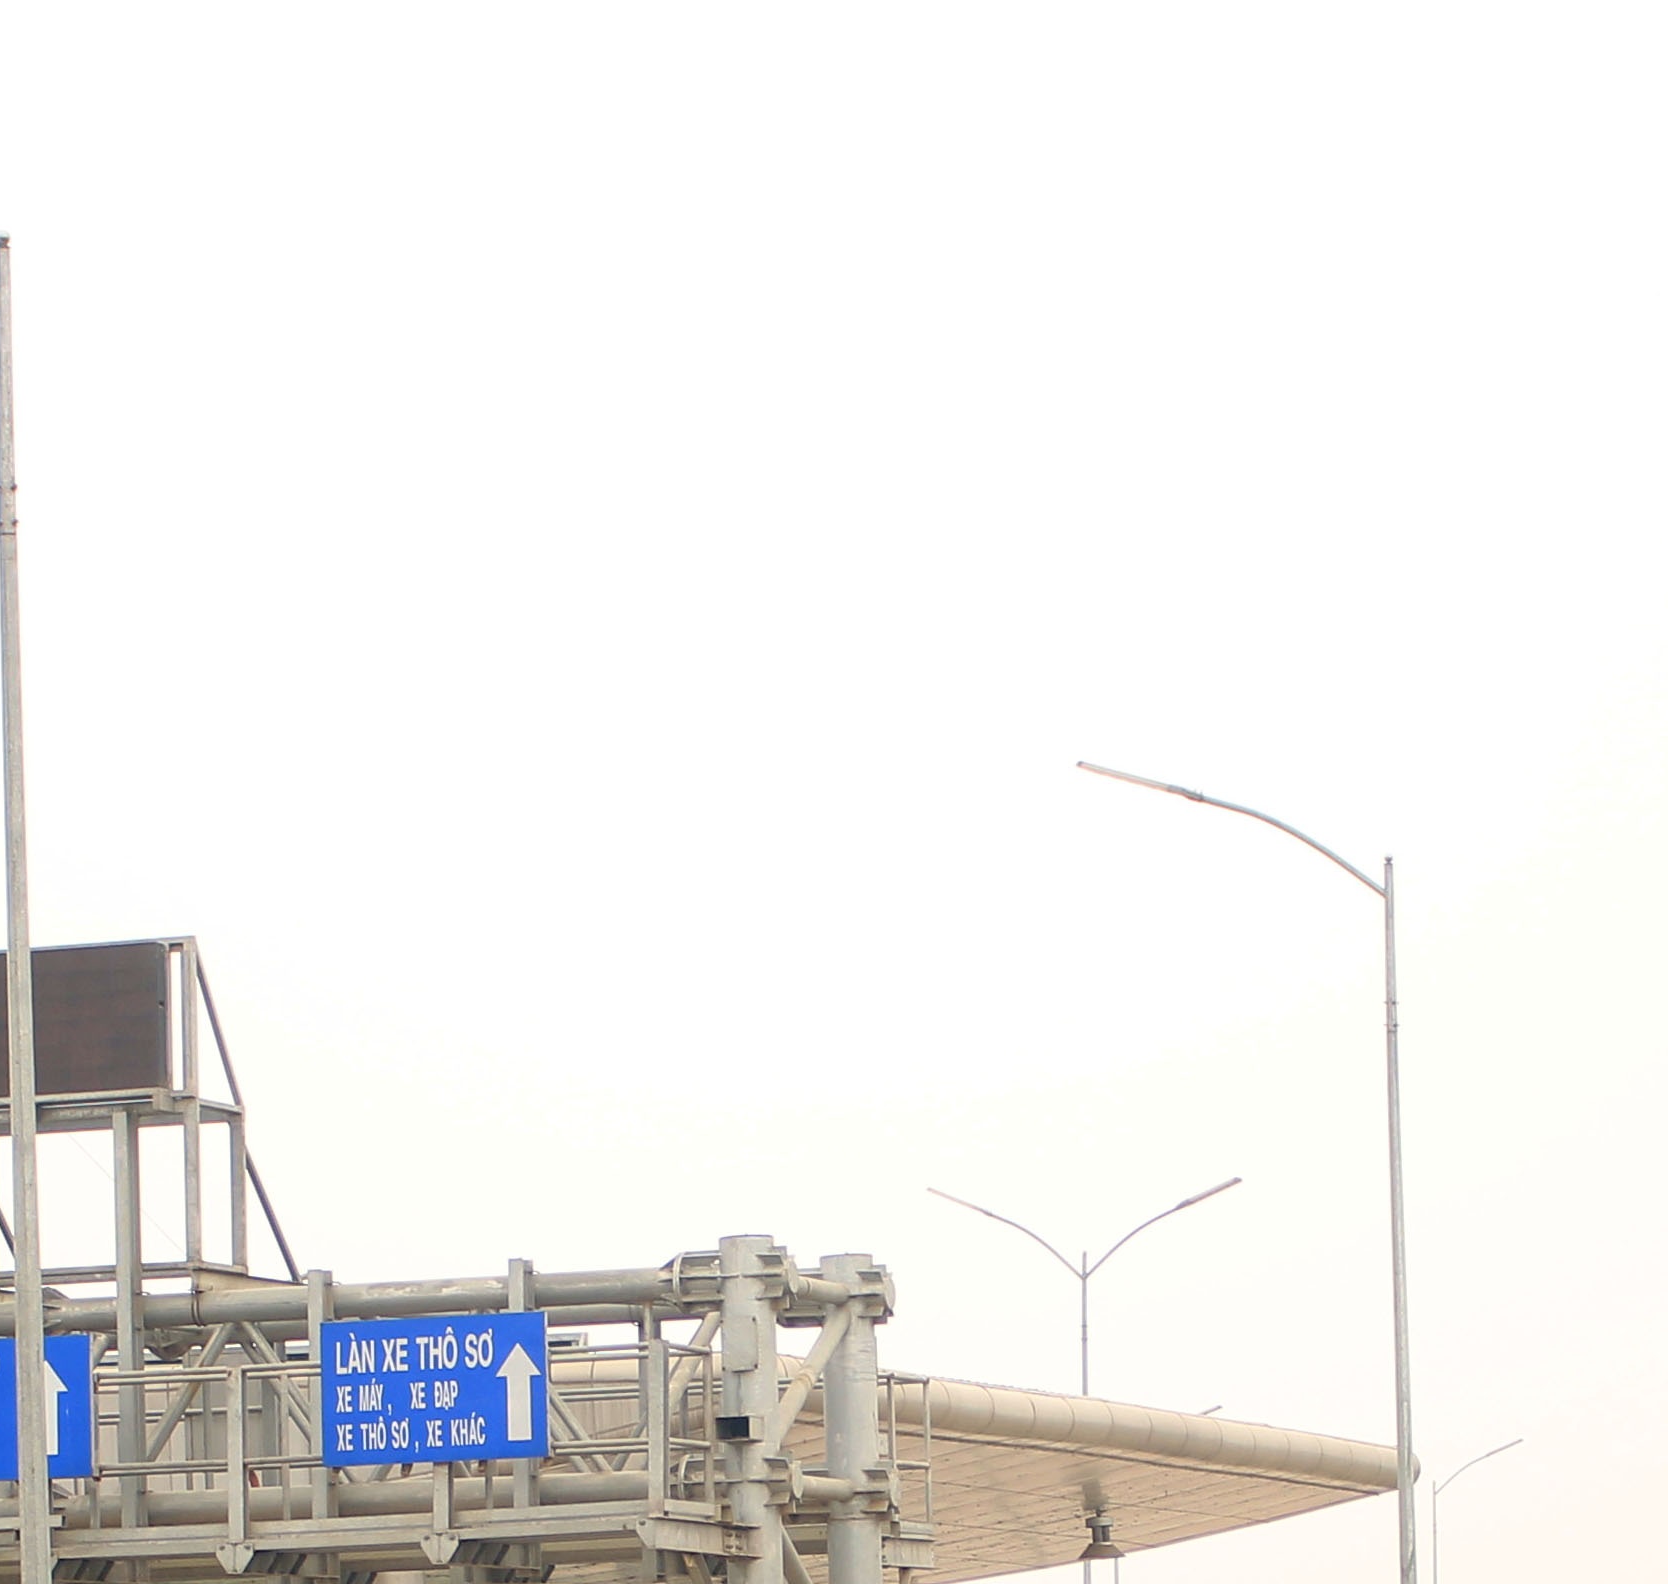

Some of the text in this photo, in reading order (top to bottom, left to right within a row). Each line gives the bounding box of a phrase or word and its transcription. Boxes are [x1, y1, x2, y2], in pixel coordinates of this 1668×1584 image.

[335, 1326, 494, 1375] LÀN XE THÔ SƠ
[336, 1385, 353, 1413] XE
[410, 1381, 426, 1410] XE
[434, 1380, 459, 1411] ĐẠP
[336, 1424, 353, 1452] XE
[360, 1416, 387, 1450] THÔ
[426, 1420, 443, 1448] XE
[451, 1412, 487, 1446] KHÁC
